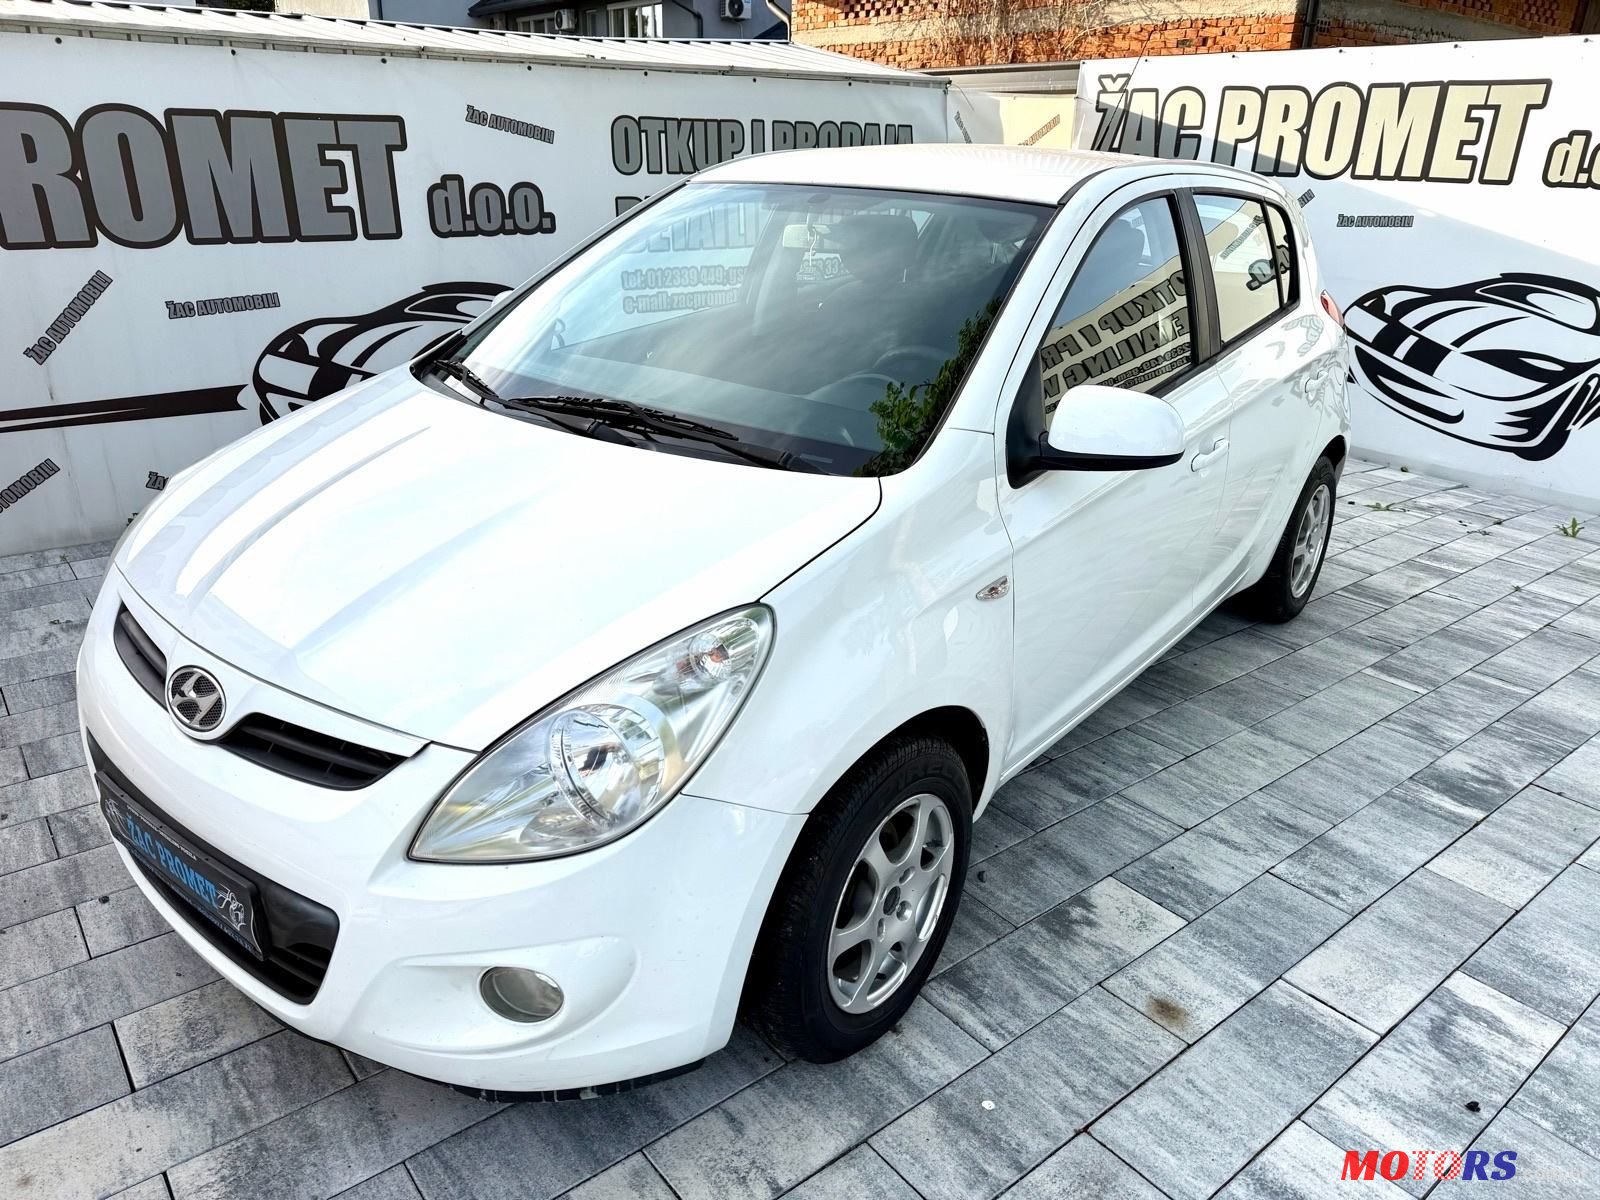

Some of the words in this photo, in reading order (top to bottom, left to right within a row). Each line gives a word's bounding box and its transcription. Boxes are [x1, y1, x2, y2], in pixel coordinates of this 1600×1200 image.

[465, 104, 488, 126] ŽAC
[488, 113, 555, 144] AUTOMOBILI
[611, 115, 745, 175] OTKUP
[1090, 73, 1206, 161] ŽAC
[1211, 78, 1552, 185] PROMET
[427, 174, 556, 238] d.o.o.
[1336, 213, 1355, 228] ŽAC
[1355, 215, 1415, 228] AUTOMOBILI
[23, 336, 56, 366] ŽAC
[45, 269, 114, 344] AUTOMOBILI
[165, 300, 196, 319] ŽAC
[196, 291, 281, 316] AUTOMOBILI
[145, 470, 169, 491] ŽA
[155, 839, 219, 910] PROMET
